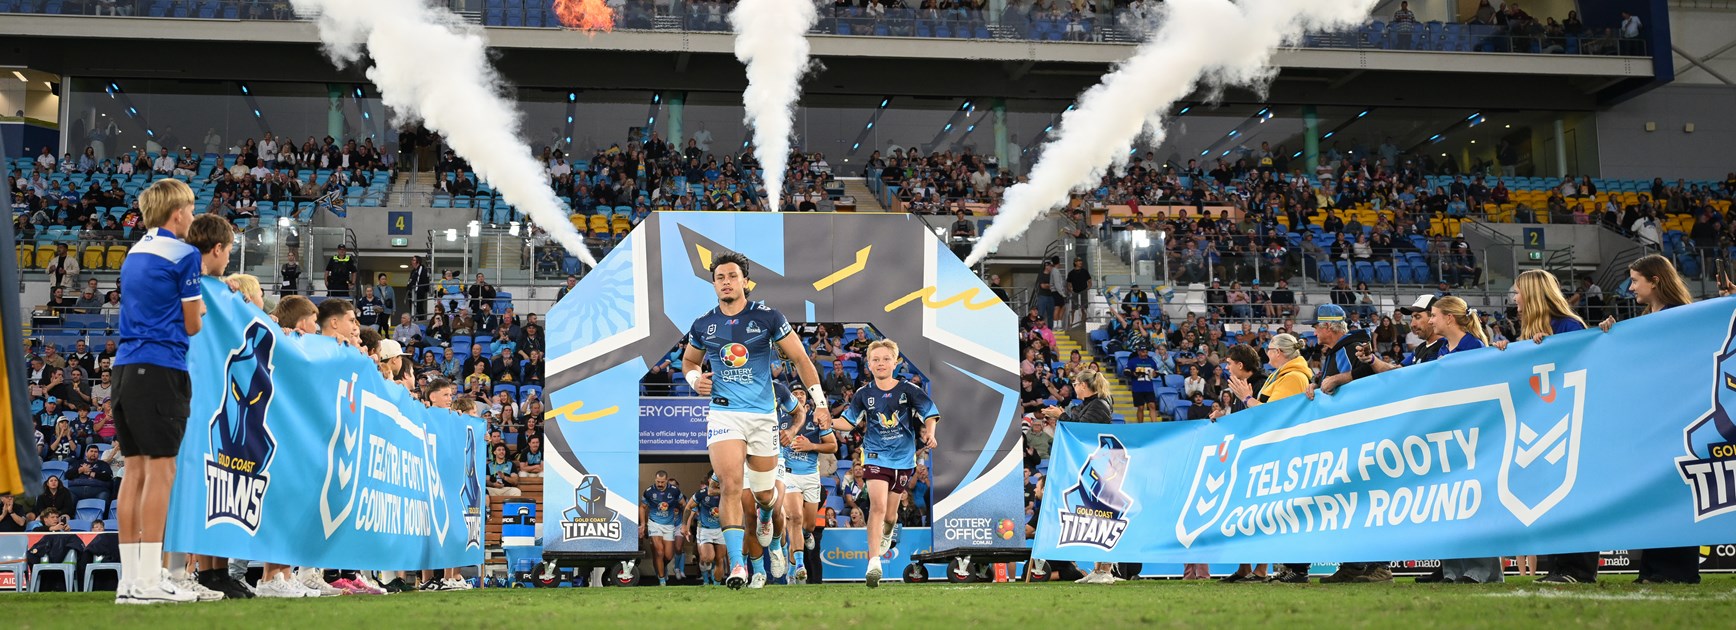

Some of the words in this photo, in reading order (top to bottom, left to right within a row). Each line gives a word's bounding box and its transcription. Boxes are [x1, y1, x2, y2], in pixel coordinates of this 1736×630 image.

[395, 215, 405, 231] 4
[1529, 231, 1539, 246] 2
[720, 368, 753, 376] LOTTERY
[722, 374, 754, 382] OFFICE
[639, 405, 662, 417] ERY
[663, 405, 709, 417] OFFICE
[218, 452, 230, 468] GOLD
[231, 457, 256, 473] COAST
[1245, 446, 1351, 499] TELSTRA
[1357, 426, 1480, 481] FOOTY
[206, 464, 266, 529] TITANS
[1076, 507, 1093, 517] GOLD
[1094, 510, 1113, 519] COAST
[1221, 491, 1358, 538] COUNTRY
[1365, 478, 1482, 528] ROUND
[563, 522, 619, 539] TITANS
[944, 518, 992, 528] LOTTERY
[1061, 514, 1126, 547] TITANS
[944, 528, 993, 540] OFFICE
